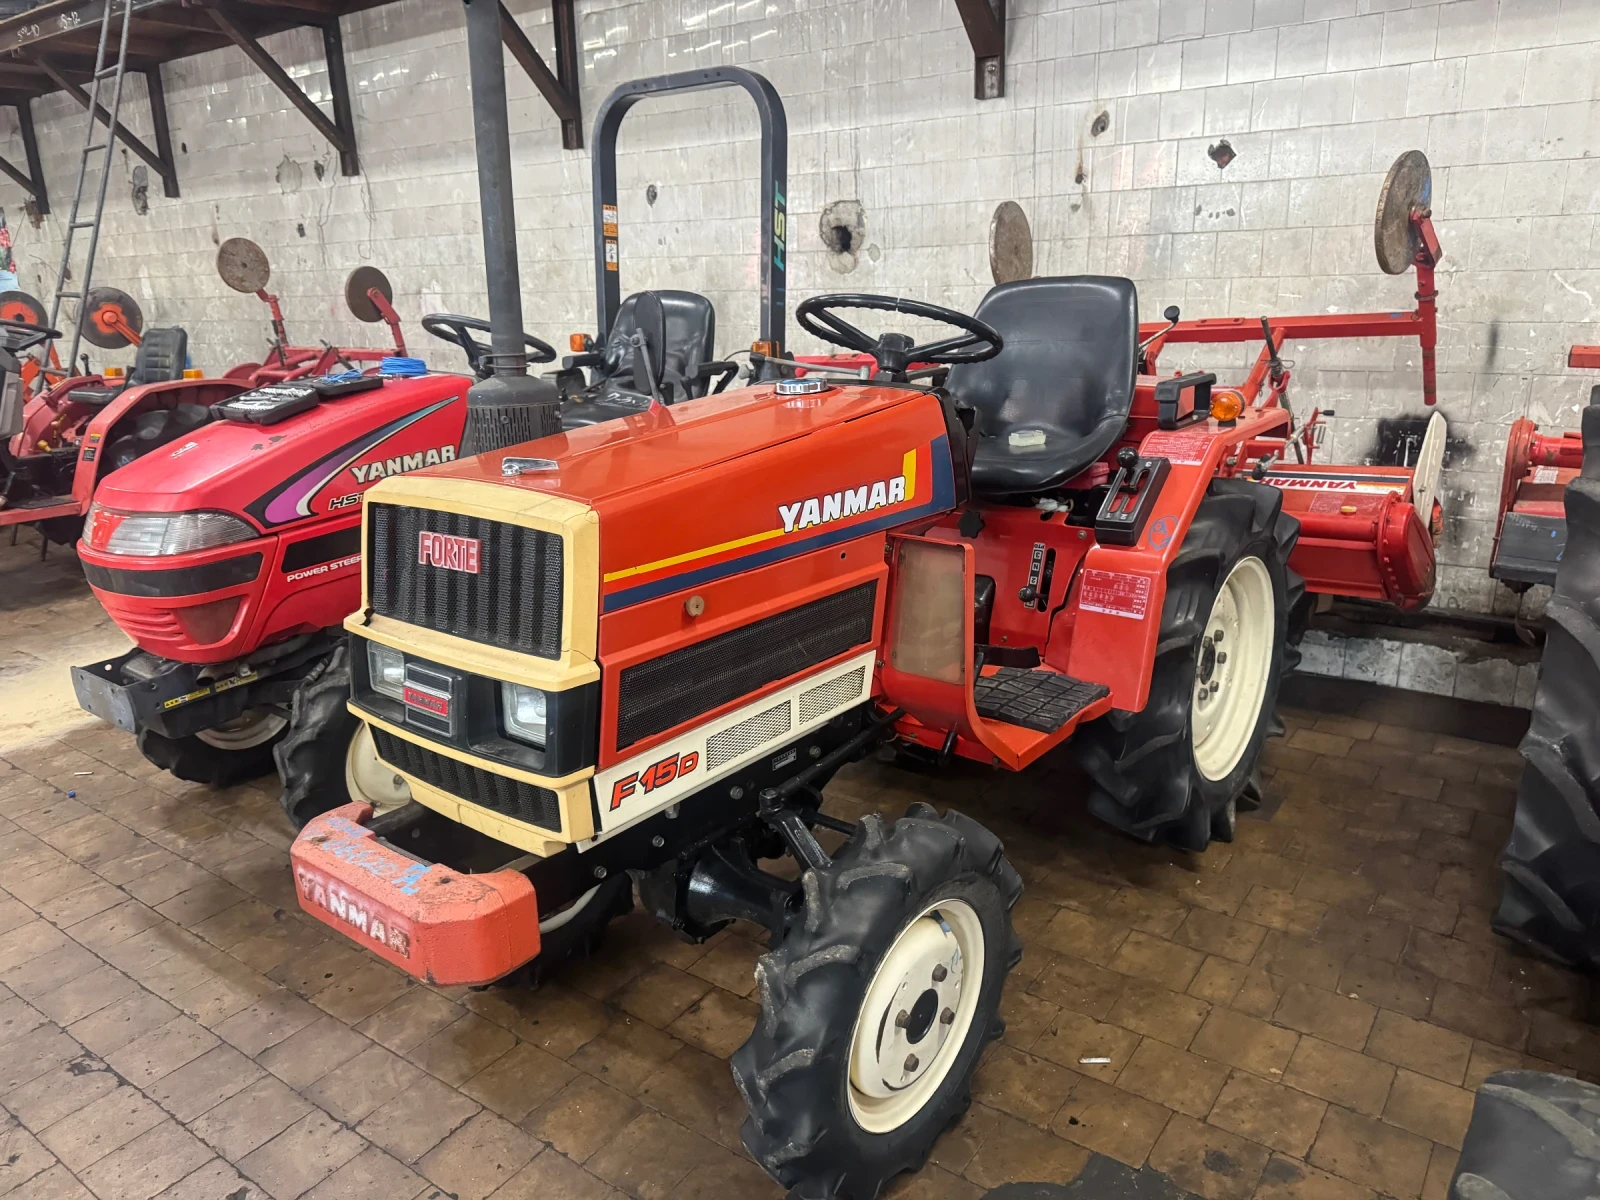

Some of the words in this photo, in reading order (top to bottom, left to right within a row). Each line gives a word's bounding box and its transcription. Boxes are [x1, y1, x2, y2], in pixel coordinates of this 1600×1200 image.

[773, 180, 786, 272] HST
[351, 445, 456, 484] YANMAR
[777, 475, 906, 533] YANMAR
[286, 564, 329, 583] POWER
[418, 530, 482, 574] FORTE
[609, 751, 699, 813] F15D
[297, 868, 411, 960] YANMAR
